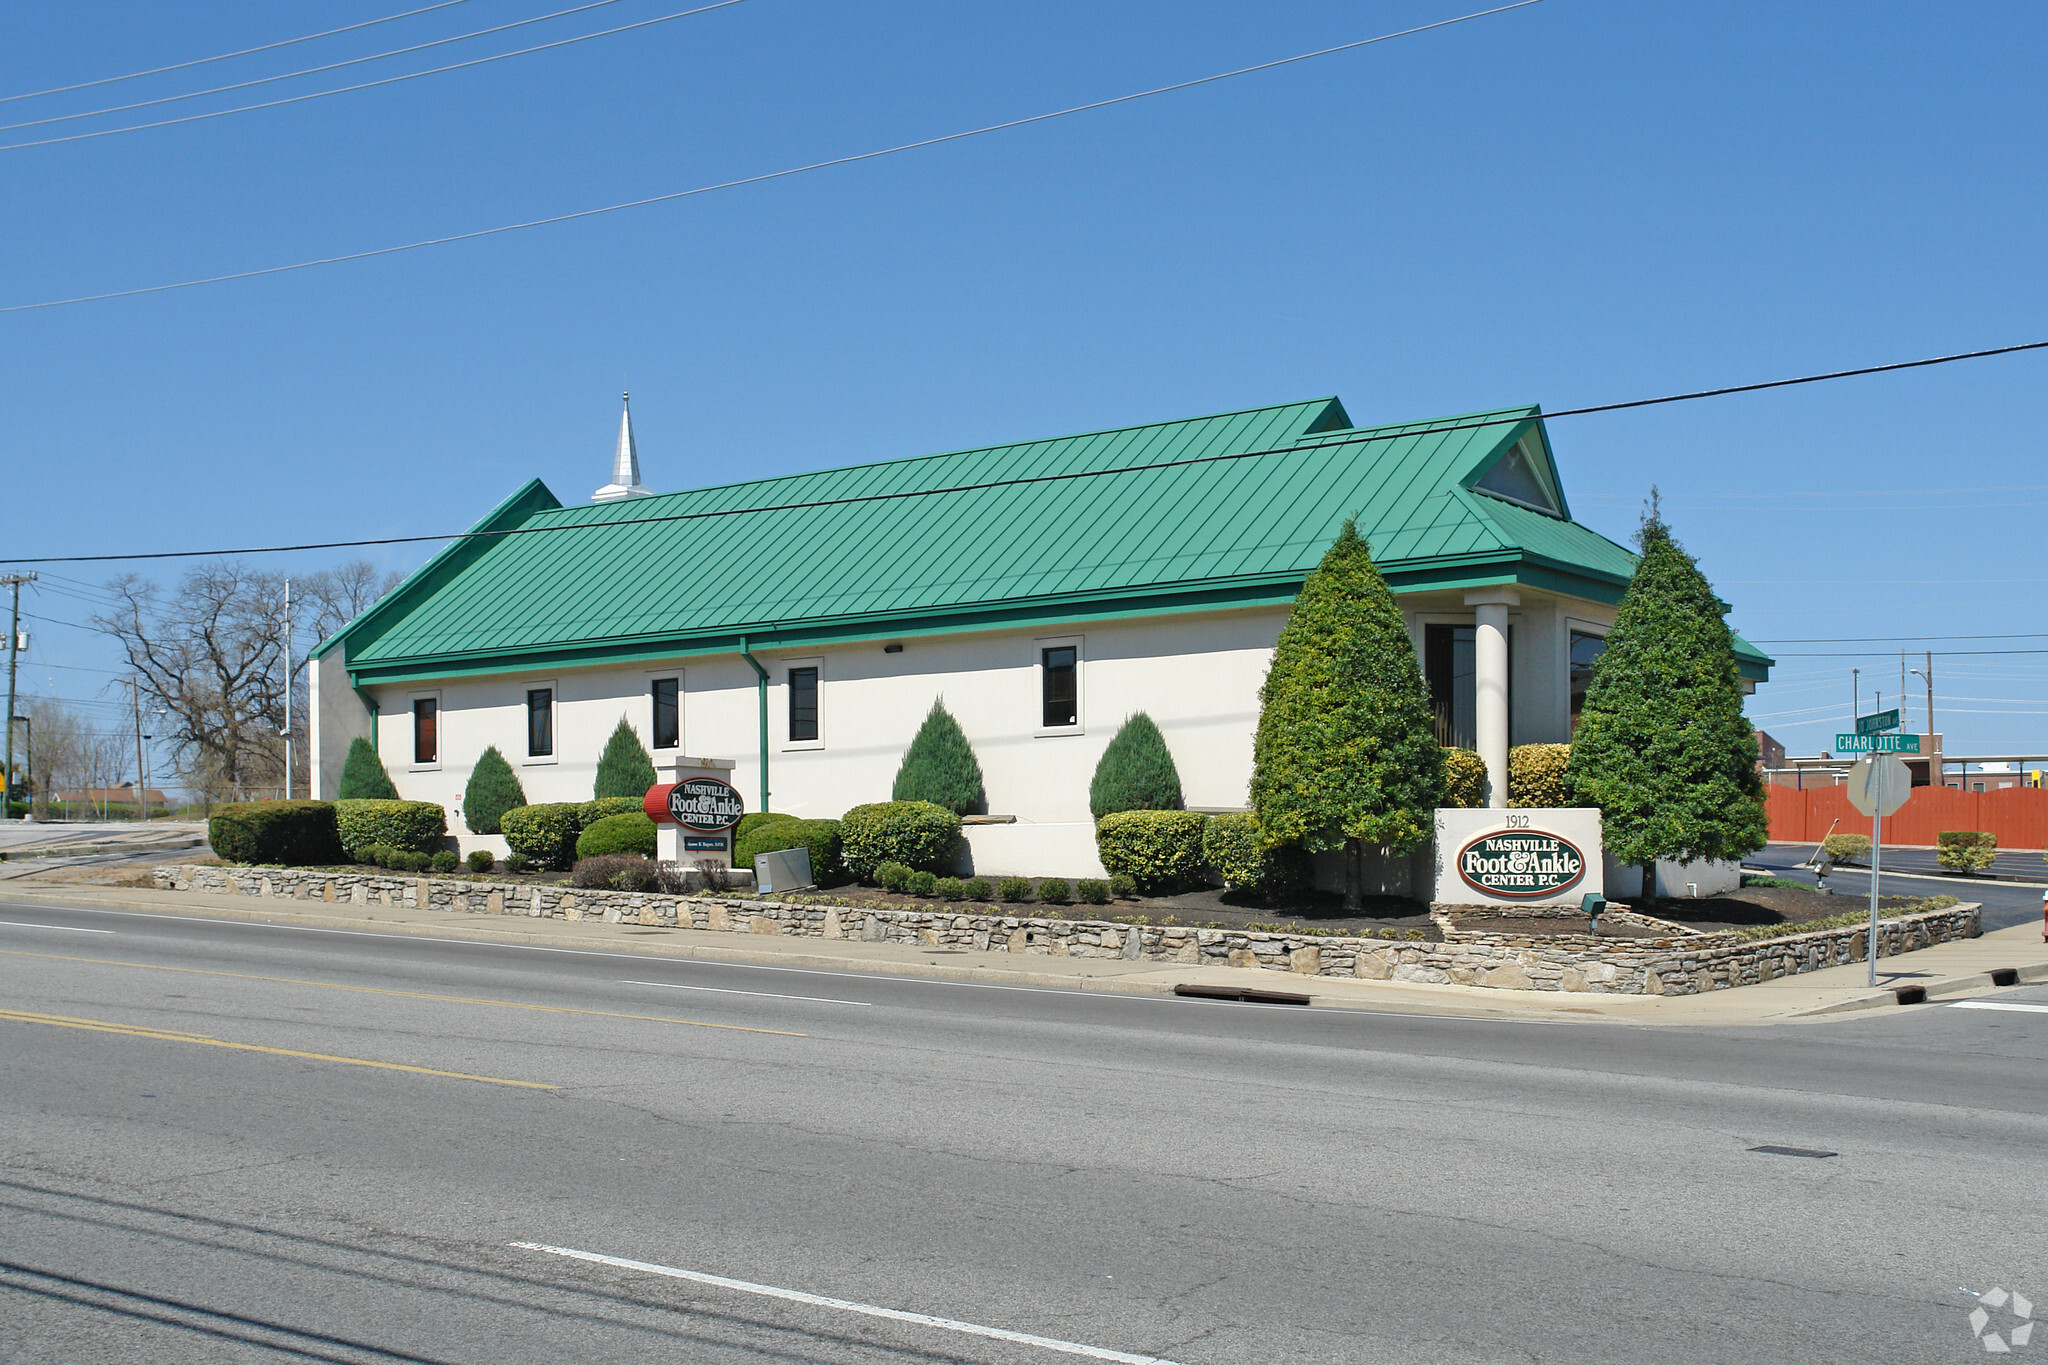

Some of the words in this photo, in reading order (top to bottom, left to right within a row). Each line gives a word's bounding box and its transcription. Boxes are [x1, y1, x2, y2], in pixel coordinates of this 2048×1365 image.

[1838, 736, 1901, 750] CHARLOTTE
[1906, 743, 1919, 751] AVE
[684, 784, 730, 797] NASHVILLE
[681, 814, 715, 825] CENTER
[1505, 815, 1530, 829] 1912
[1485, 839, 1560, 852] NASHVILLE
[1481, 874, 1535, 886] CENTER
[1538, 875, 1561, 886] P.C.
